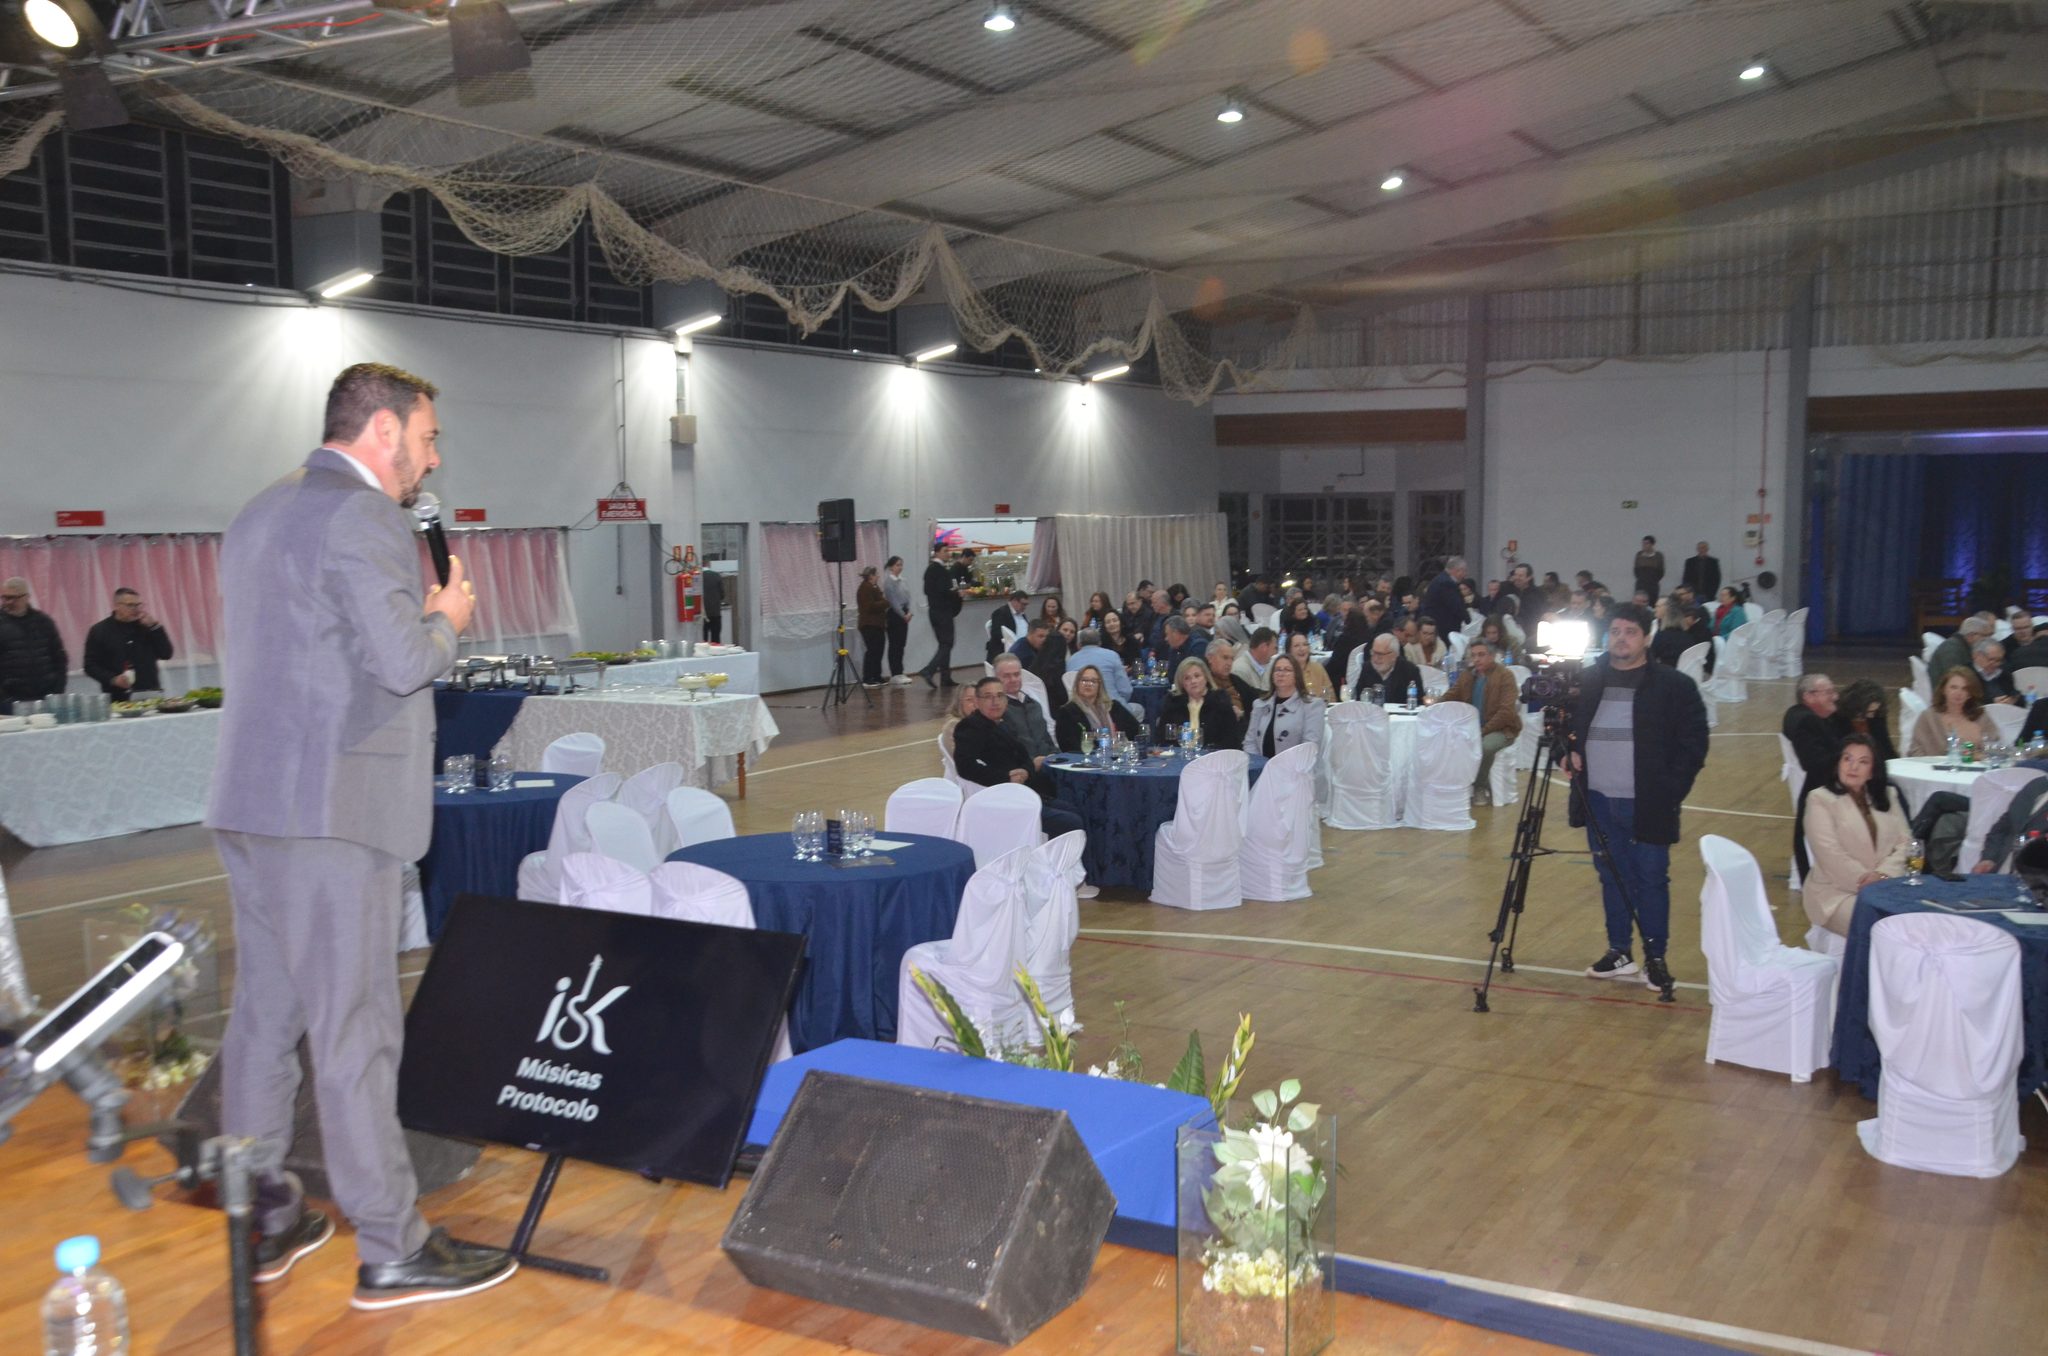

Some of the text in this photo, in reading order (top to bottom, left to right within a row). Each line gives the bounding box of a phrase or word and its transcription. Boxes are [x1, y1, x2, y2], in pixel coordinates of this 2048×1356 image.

[627, 502, 637, 510] DE
[515, 1056, 603, 1091] Músicas
[497, 1084, 599, 1122] Protocolo
